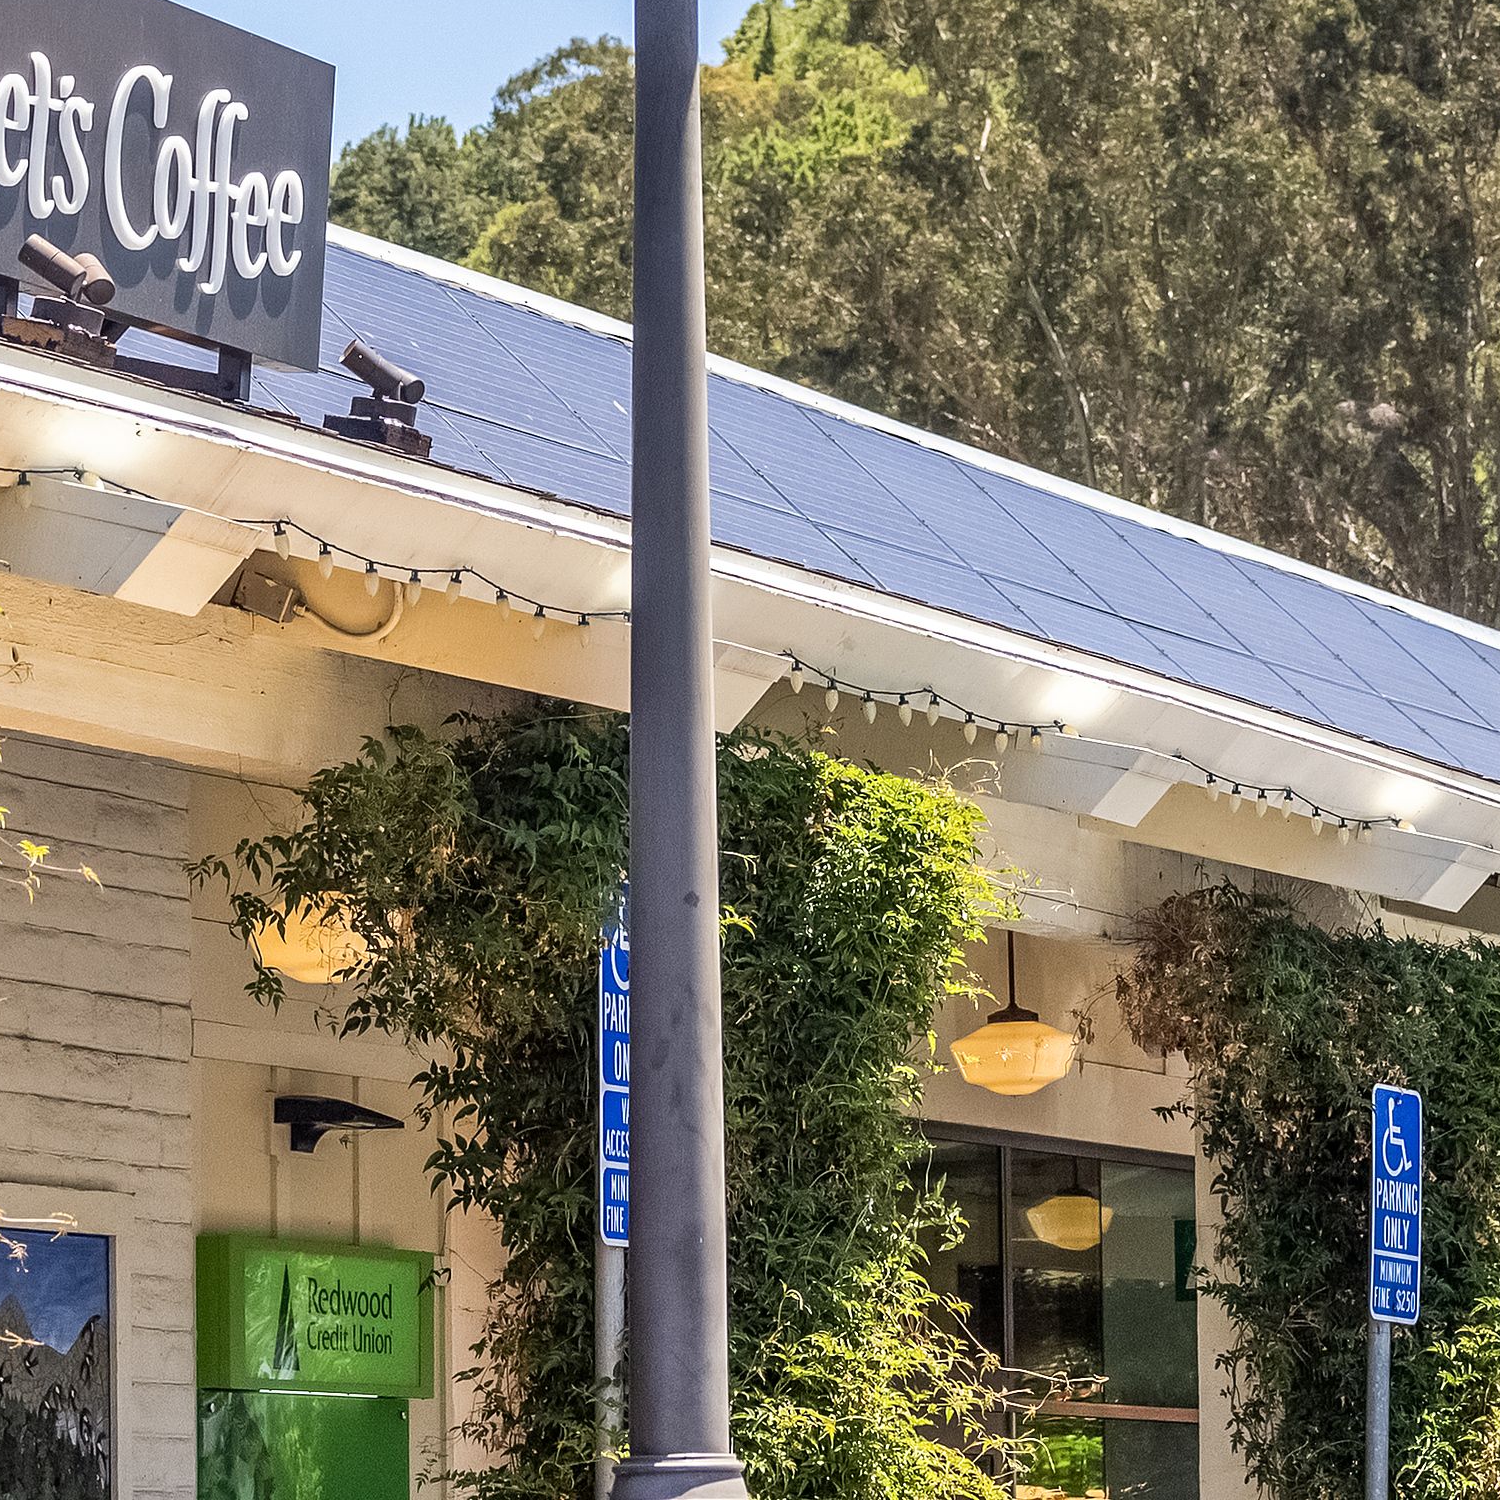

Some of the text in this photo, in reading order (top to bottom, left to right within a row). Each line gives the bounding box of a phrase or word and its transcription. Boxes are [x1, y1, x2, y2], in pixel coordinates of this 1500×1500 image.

[105, 65, 303, 293] Coffee
[1376, 1178, 1418, 1215] PARKING
[606, 1205, 625, 1233] FINE
[1383, 1217, 1410, 1250] ONLY
[1379, 1260, 1412, 1285] MINIMUM
[308, 1277, 393, 1319] Redwood
[1374, 1287, 1416, 1312] FINE $250
[307, 1321, 393, 1354] Credit Union
